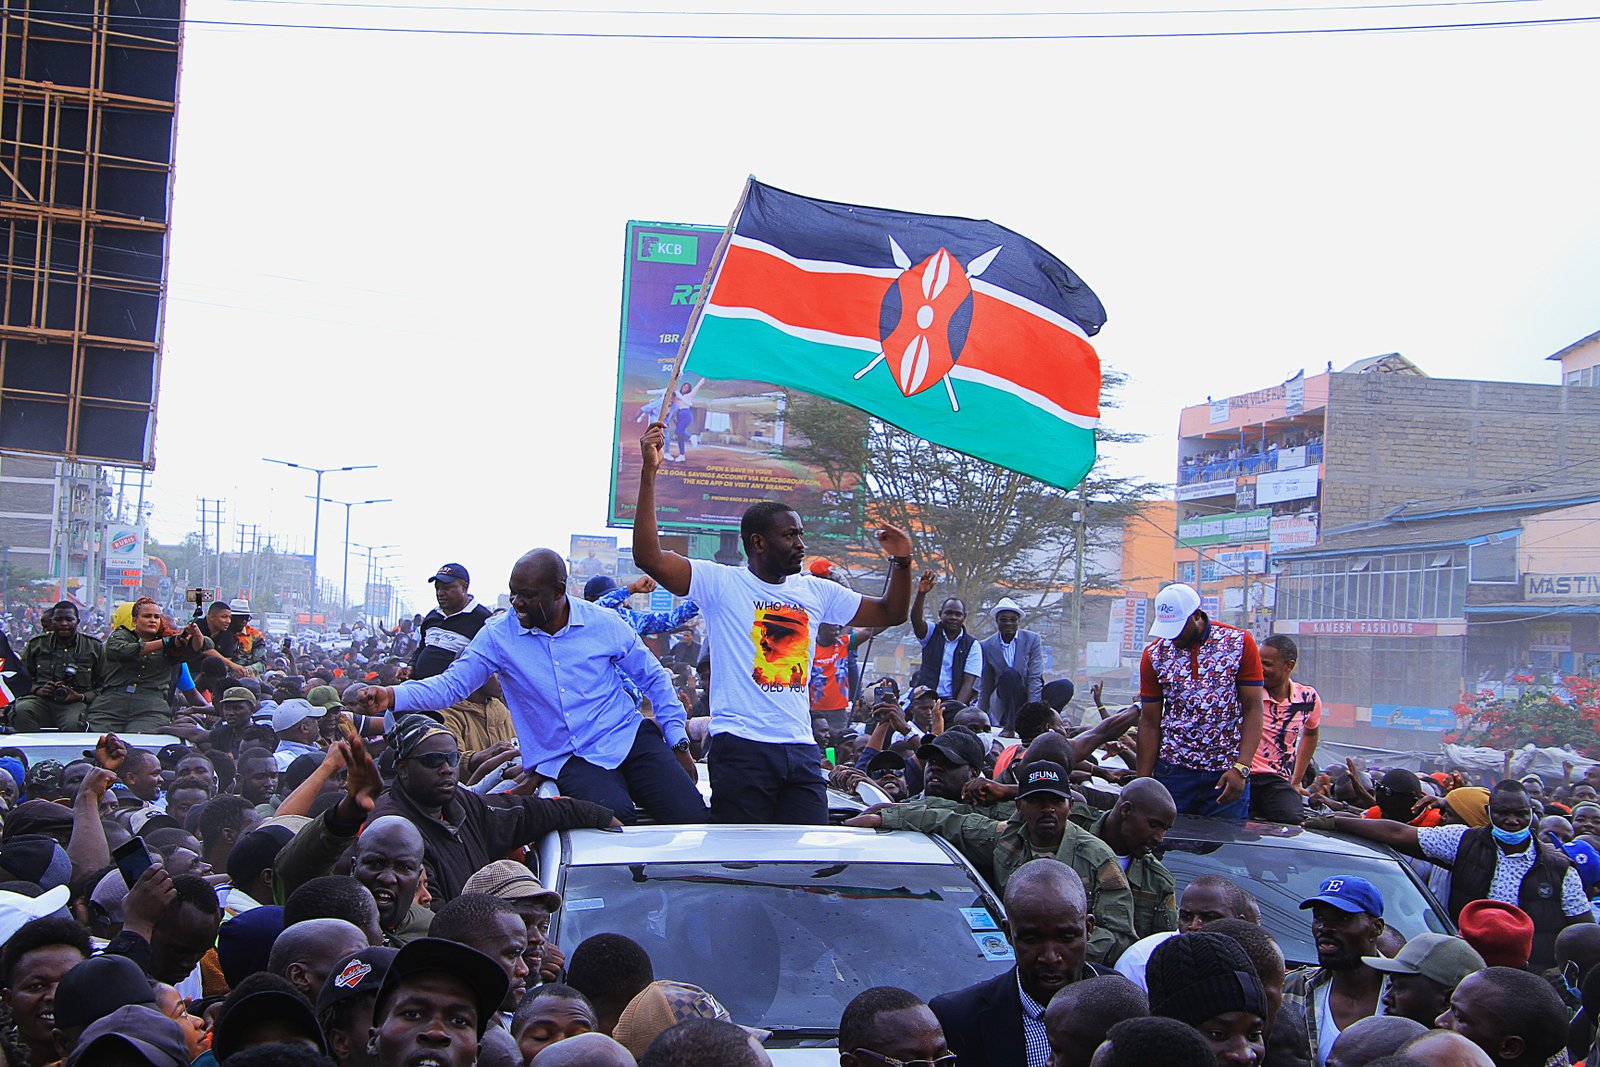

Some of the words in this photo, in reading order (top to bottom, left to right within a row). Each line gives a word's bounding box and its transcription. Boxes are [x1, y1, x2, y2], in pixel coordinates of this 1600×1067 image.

[658, 243, 682, 255] KCB
[659, 334, 680, 343] 1BR
[114, 536, 135, 549] RUBIS
[753, 600, 781, 611] WHO
[1123, 600, 1135, 650] DRIVING
[1134, 600, 1146, 650] SCHOOL
[1313, 623, 1352, 633] KAMESH
[1361, 622, 1413, 633] FASHIONS
[761, 682, 784, 692] OLD
[1029, 770, 1059, 780] SIFUNA
[1325, 880, 1344, 892] E
